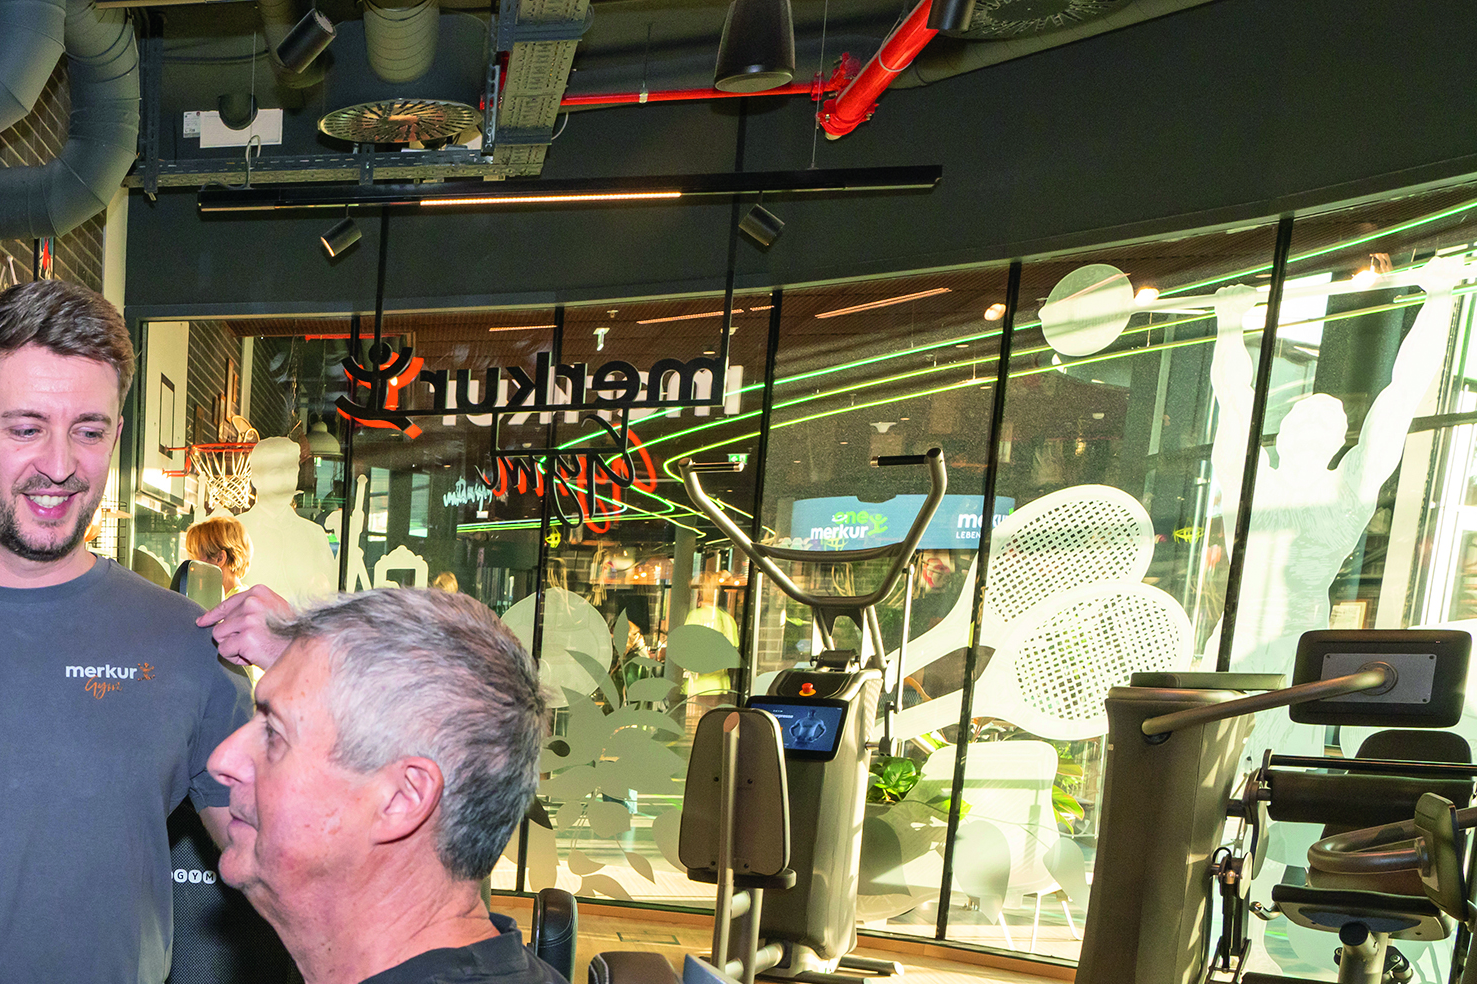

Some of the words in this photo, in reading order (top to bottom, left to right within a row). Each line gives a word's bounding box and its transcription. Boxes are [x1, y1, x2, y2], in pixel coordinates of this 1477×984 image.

[810, 523, 869, 540] merkur
[65, 664, 138, 680] merkur
[173, 870, 216, 883] GYM
